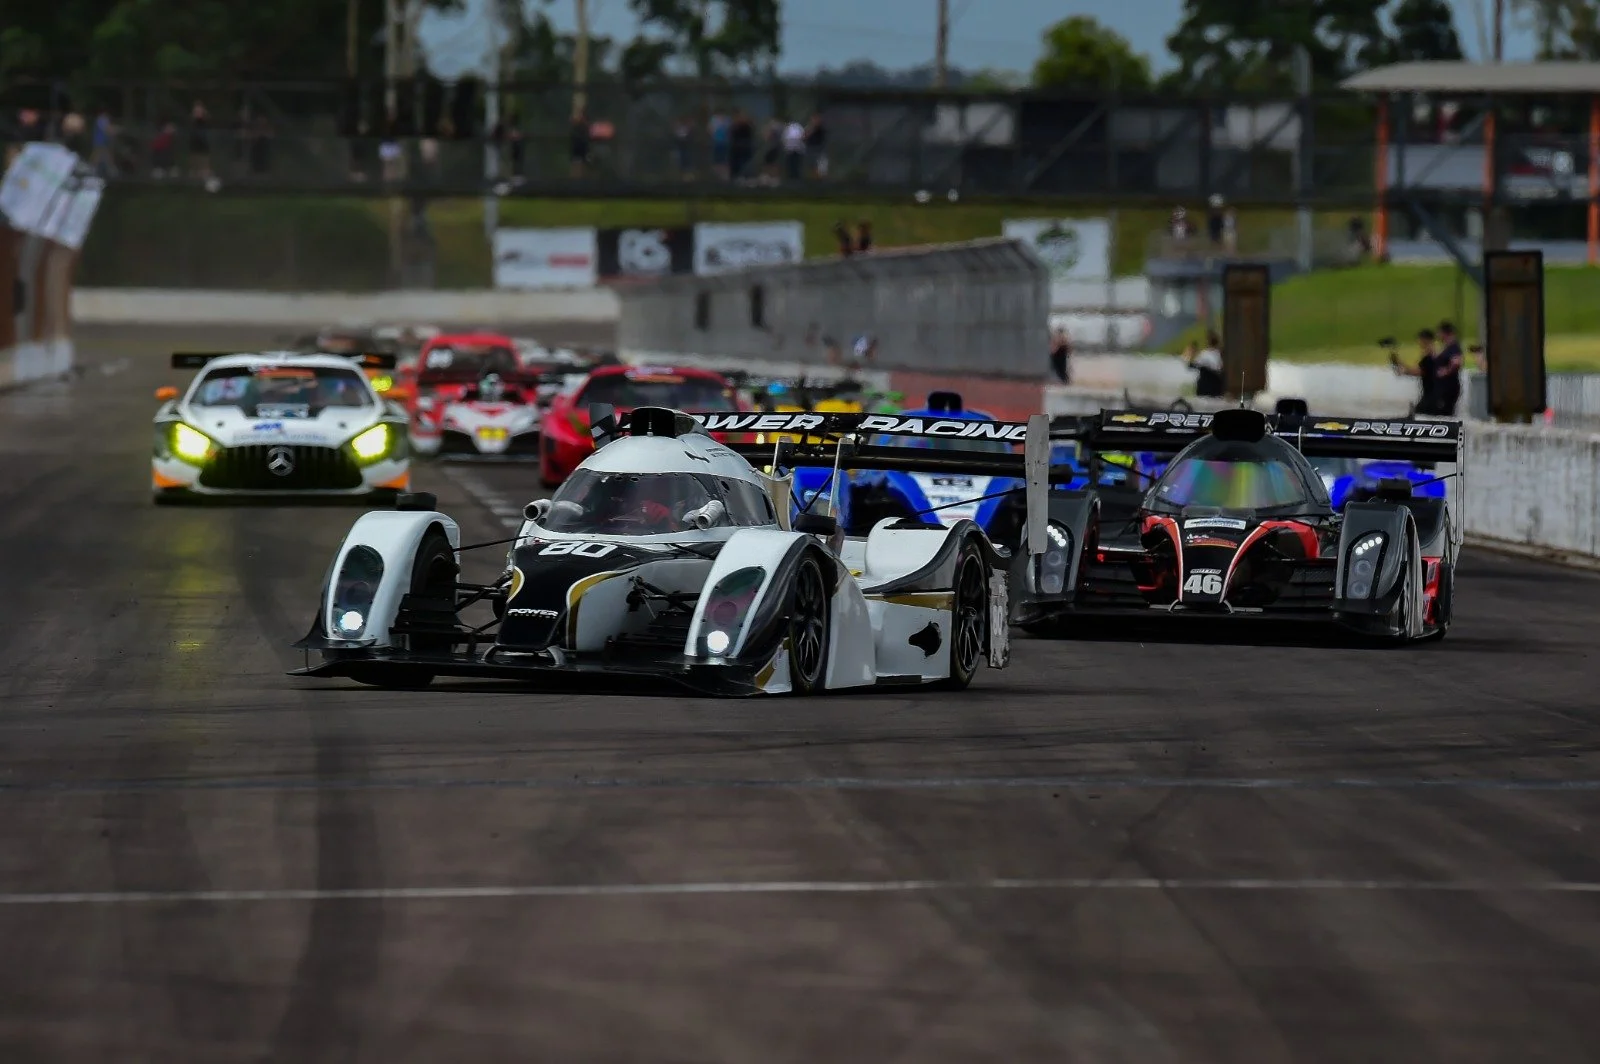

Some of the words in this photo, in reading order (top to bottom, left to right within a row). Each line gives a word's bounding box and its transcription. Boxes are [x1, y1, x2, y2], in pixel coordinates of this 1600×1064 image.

[622, 414, 825, 430] WER
[1147, 412, 1215, 428] PRET
[1350, 421, 1450, 437] PRETTO
[538, 541, 618, 558] 80
[1183, 574, 1223, 594] 46
[507, 608, 559, 617] POWER
